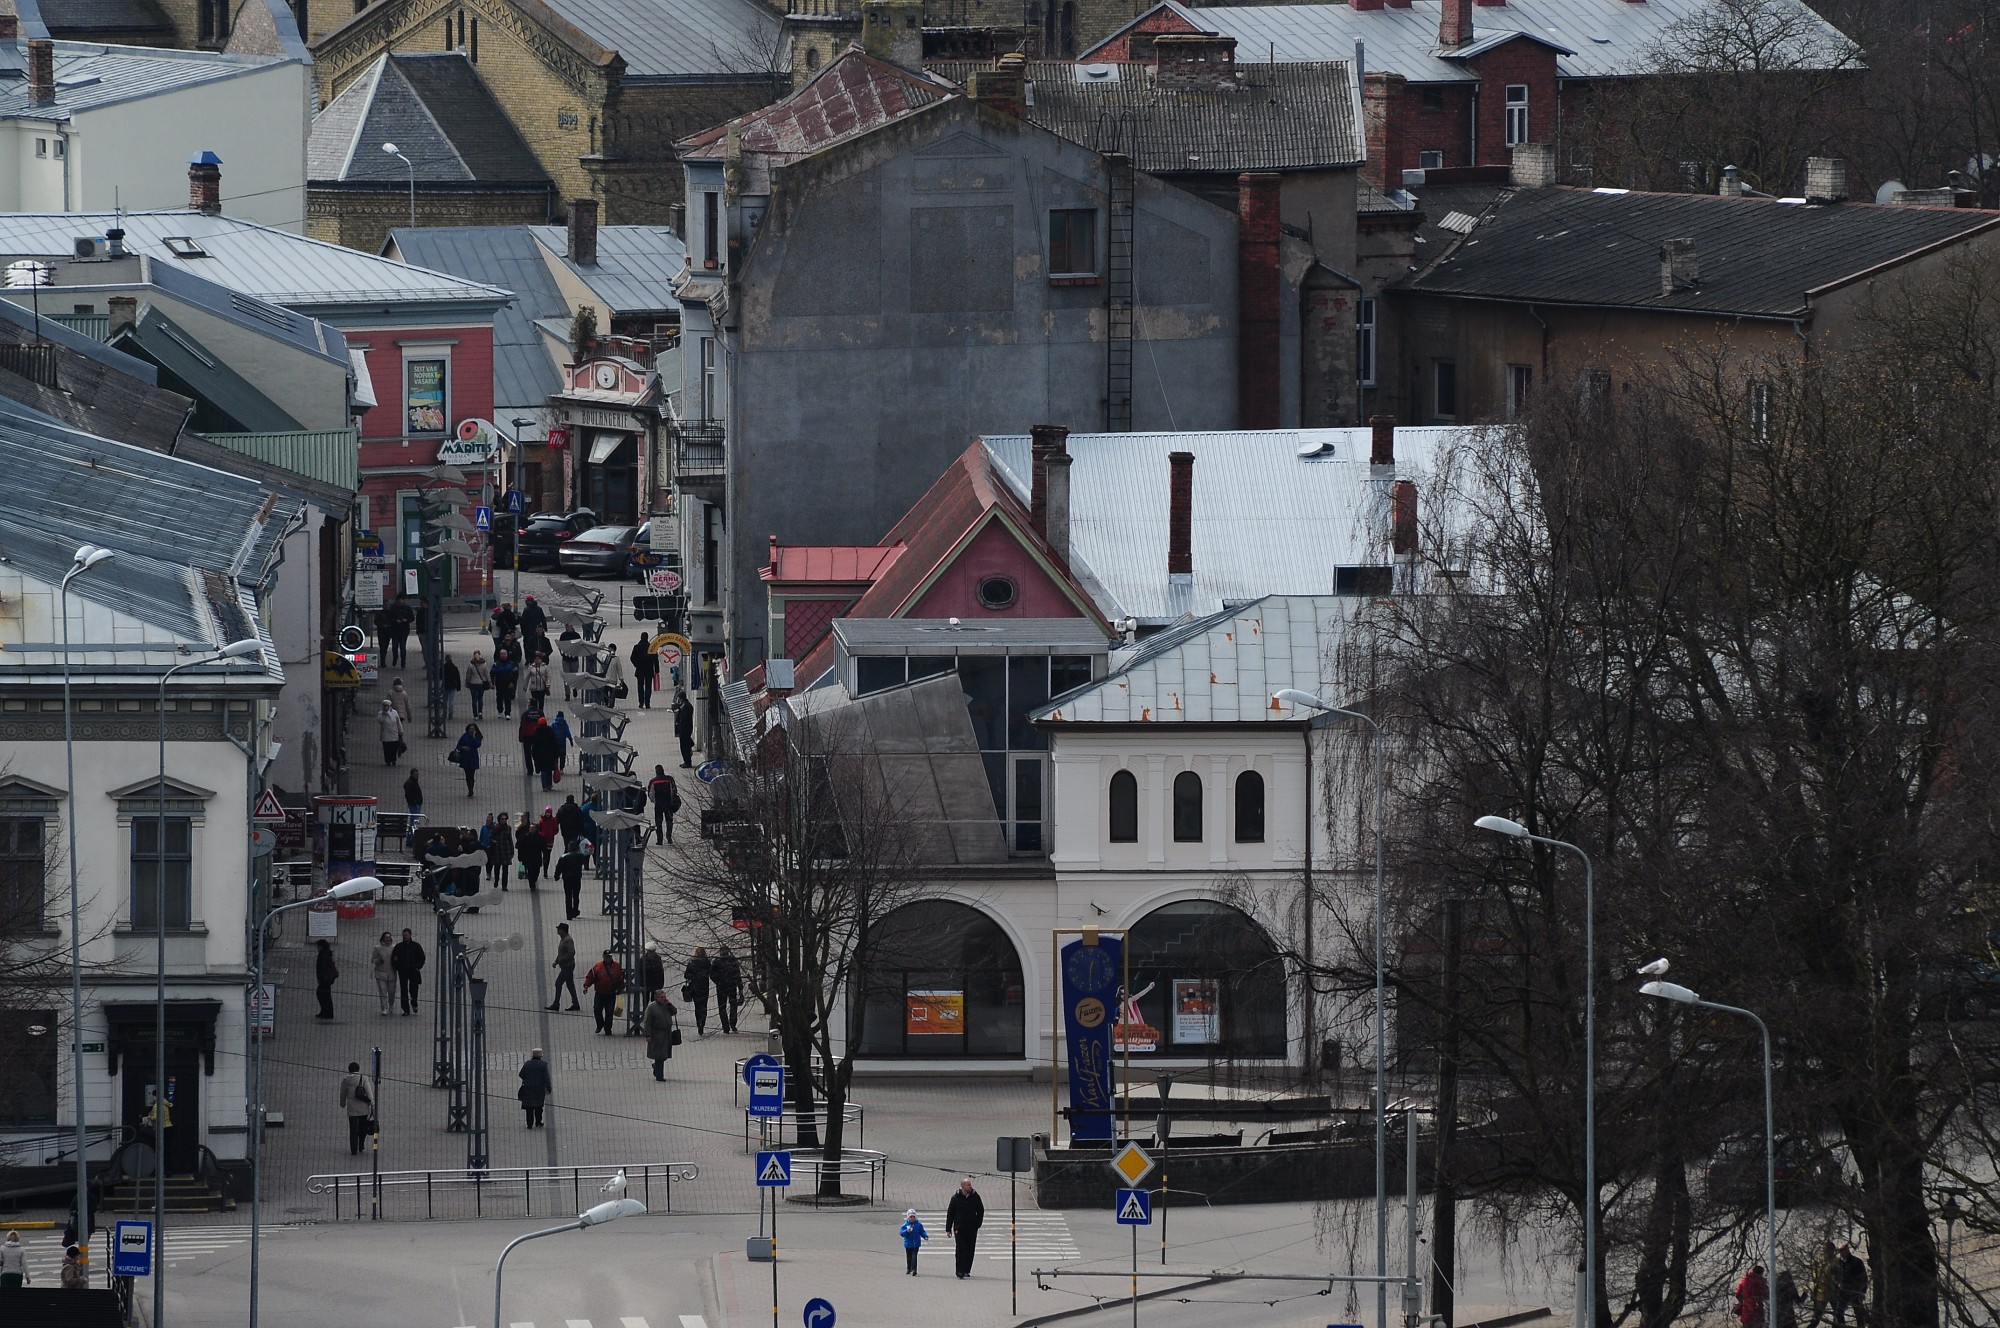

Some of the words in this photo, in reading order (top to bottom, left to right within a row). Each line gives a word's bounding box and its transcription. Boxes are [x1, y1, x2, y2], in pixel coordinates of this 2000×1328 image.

[581, 410, 629, 429] BOULANGERIE
[549, 432, 565, 446] illy
[264, 804, 273, 813] M
[1079, 1003, 1103, 1021] Fazer
